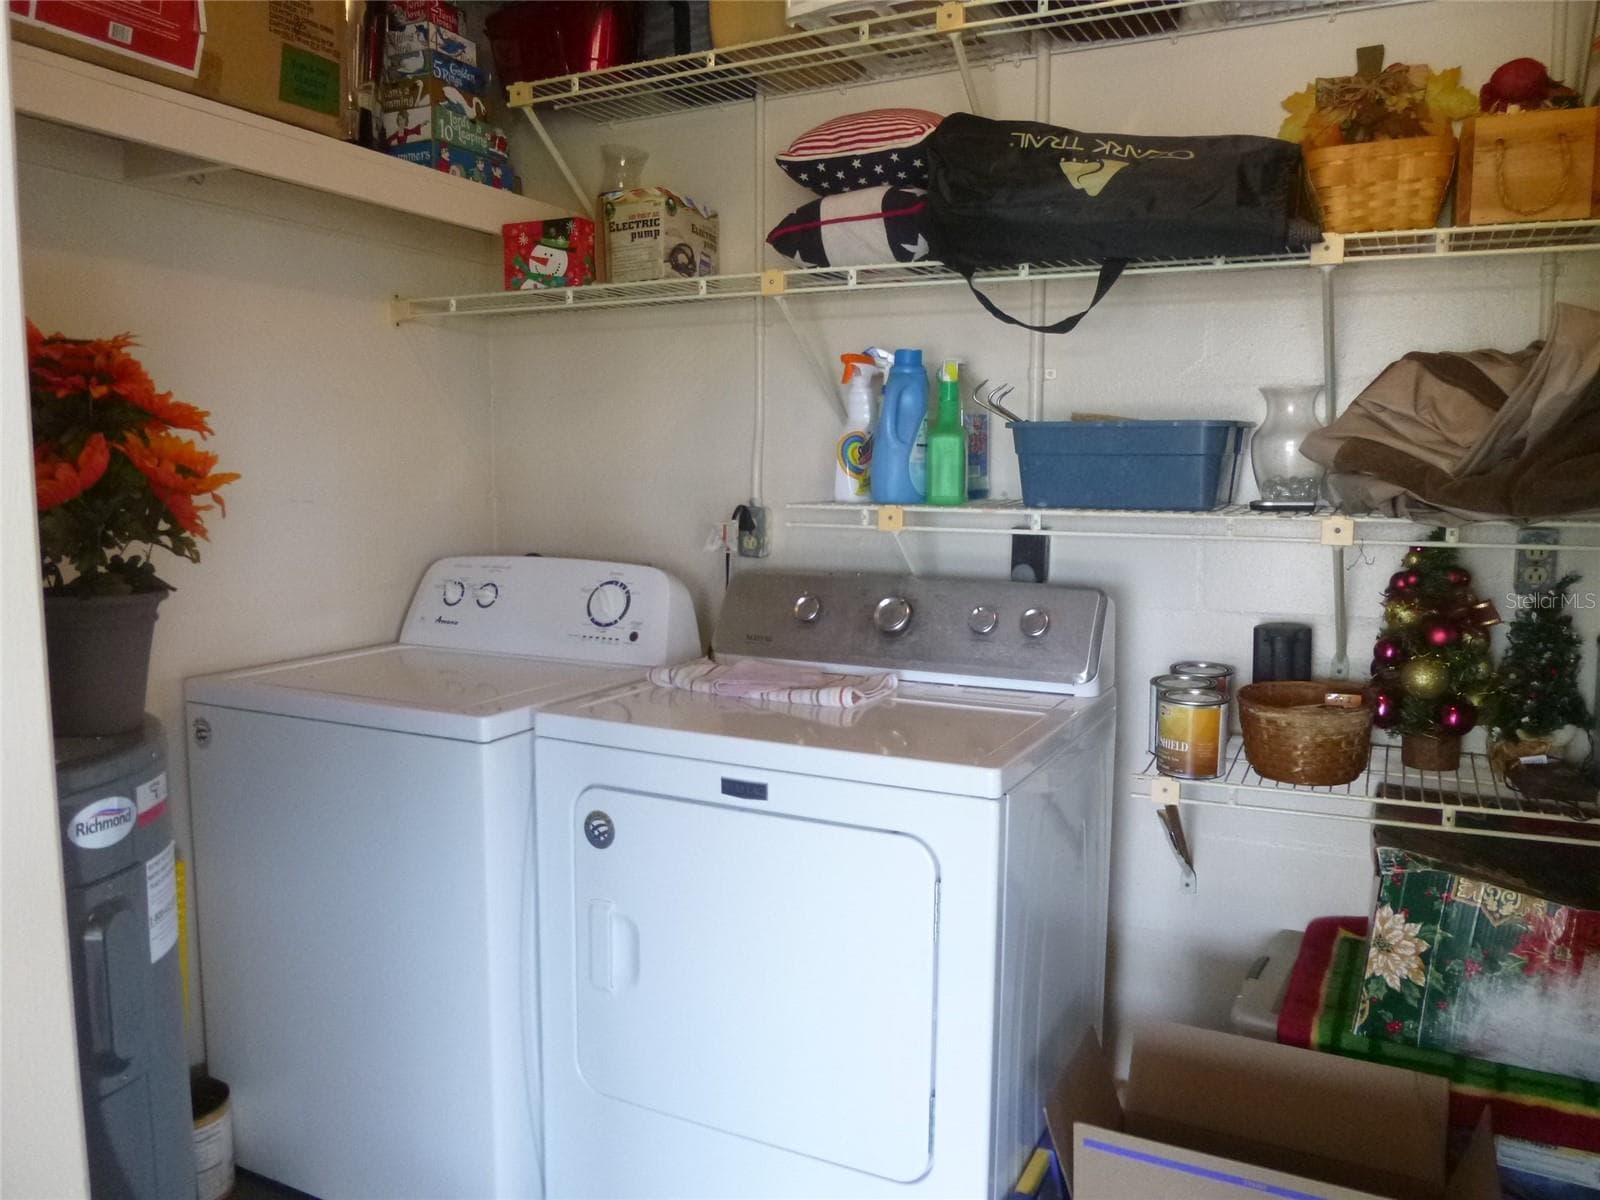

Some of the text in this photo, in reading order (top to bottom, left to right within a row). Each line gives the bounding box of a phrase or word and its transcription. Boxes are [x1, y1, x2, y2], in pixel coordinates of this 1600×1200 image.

[433, 60, 442, 79] 5
[442, 70, 463, 87] Rings
[449, 63, 476, 84] Golden
[448, 110, 470, 129] Lords
[440, 119, 454, 141] 10
[458, 127, 488, 149] Leaping
[608, 218, 661, 232] ELECTRIC
[631, 229, 661, 242] pump
[75, 807, 131, 837] Richmond
